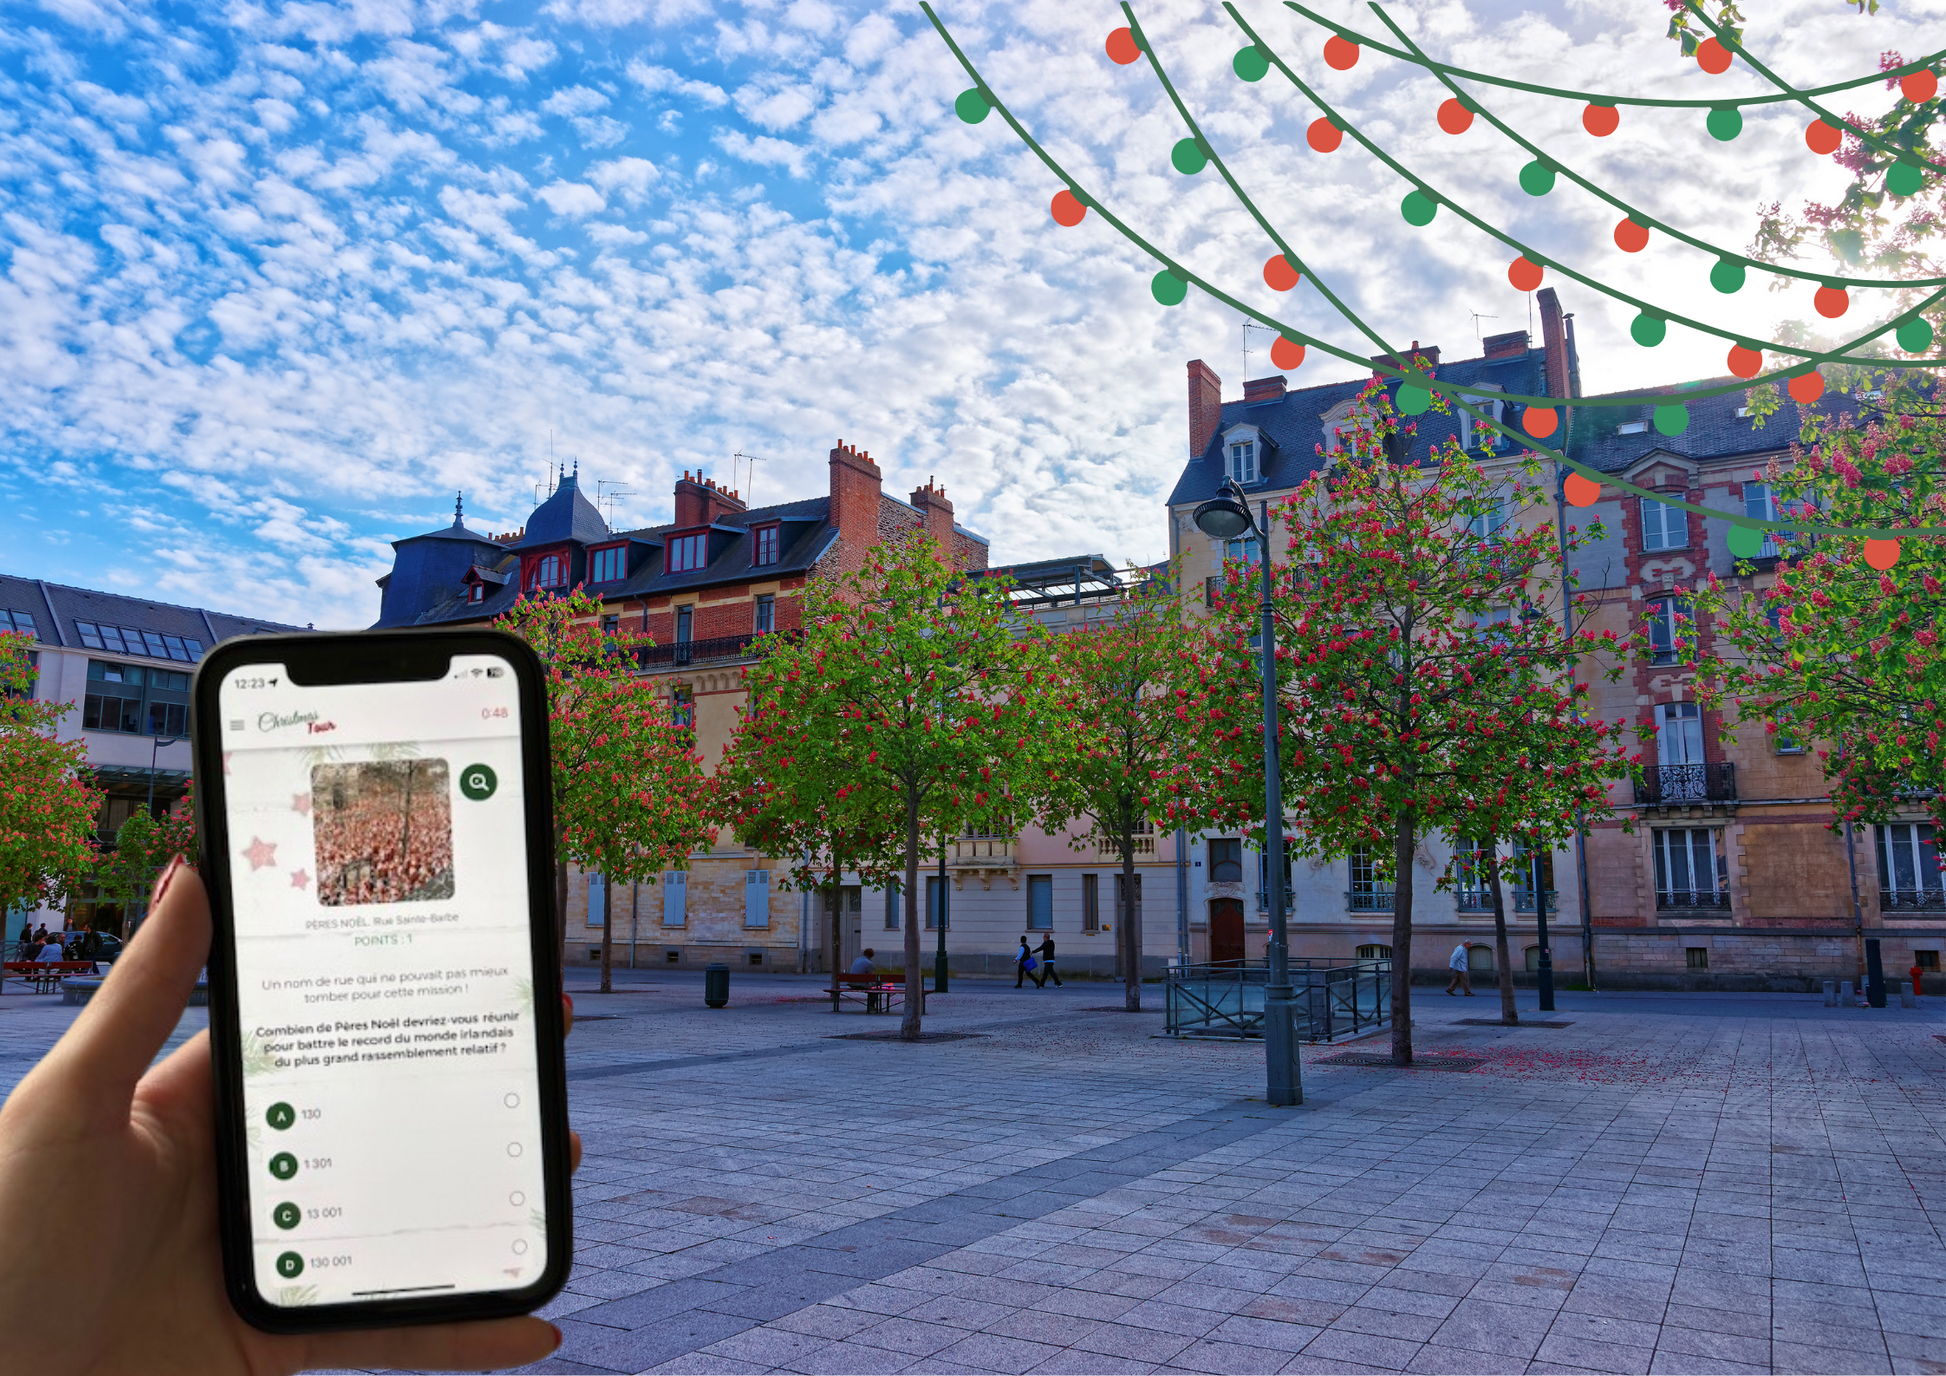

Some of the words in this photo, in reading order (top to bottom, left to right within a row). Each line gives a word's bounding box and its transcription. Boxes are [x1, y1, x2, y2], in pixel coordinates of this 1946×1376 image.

[235, 678, 265, 689] 12:23
[258, 711, 319, 733] Christmas
[373, 915, 394, 926] Rue
[396, 912, 460, 926] Sainte-Barbe
[354, 934, 398, 947] POINTS
[406, 933, 413, 944] 1
[262, 979, 282, 990] Un
[283, 979, 313, 989] nom
[315, 976, 331, 987] de
[334, 976, 354, 985] rue
[356, 972, 378, 985] qui
[380, 973, 396, 981] ne
[400, 969, 443, 983] pouvait
[445, 968, 467, 979] pas
[469, 965, 508, 976] mieux
[304, 992, 349, 1003] tomber
[351, 990, 381, 1001] pour
[384, 987, 414, 998] cette
[417, 984, 463, 996] mission
[255, 1025, 315, 1038] Combien
[316, 1022, 332, 1033] de
[334, 1020, 368, 1032] Pères
[370, 1018, 399, 1029] Noël
[483, 1010, 519, 1023] réunir
[263, 1042, 295, 1055] pour
[297, 1039, 335, 1051] battre
[338, 1036, 349, 1047] le
[351, 1034, 392, 1046] record
[394, 1033, 411, 1043] du
[414, 1030, 457, 1042] monde
[274, 1056, 291, 1068] du
[294, 1055, 320, 1068] plus
[322, 1051, 359, 1067] grand
[361, 1046, 458, 1062] rassemblement
[460, 1042, 498, 1055] relatif
[276, 1111, 287, 1122] A
[301, 1108, 321, 1120] 130
[279, 1160, 289, 1172] B
[281, 1210, 292, 1221] C
[307, 1208, 319, 1219] 13
[322, 1207, 342, 1217] 001
[285, 1259, 295, 1271] D
[310, 1257, 329, 1268] 130
[332, 1255, 353, 1267] 001
